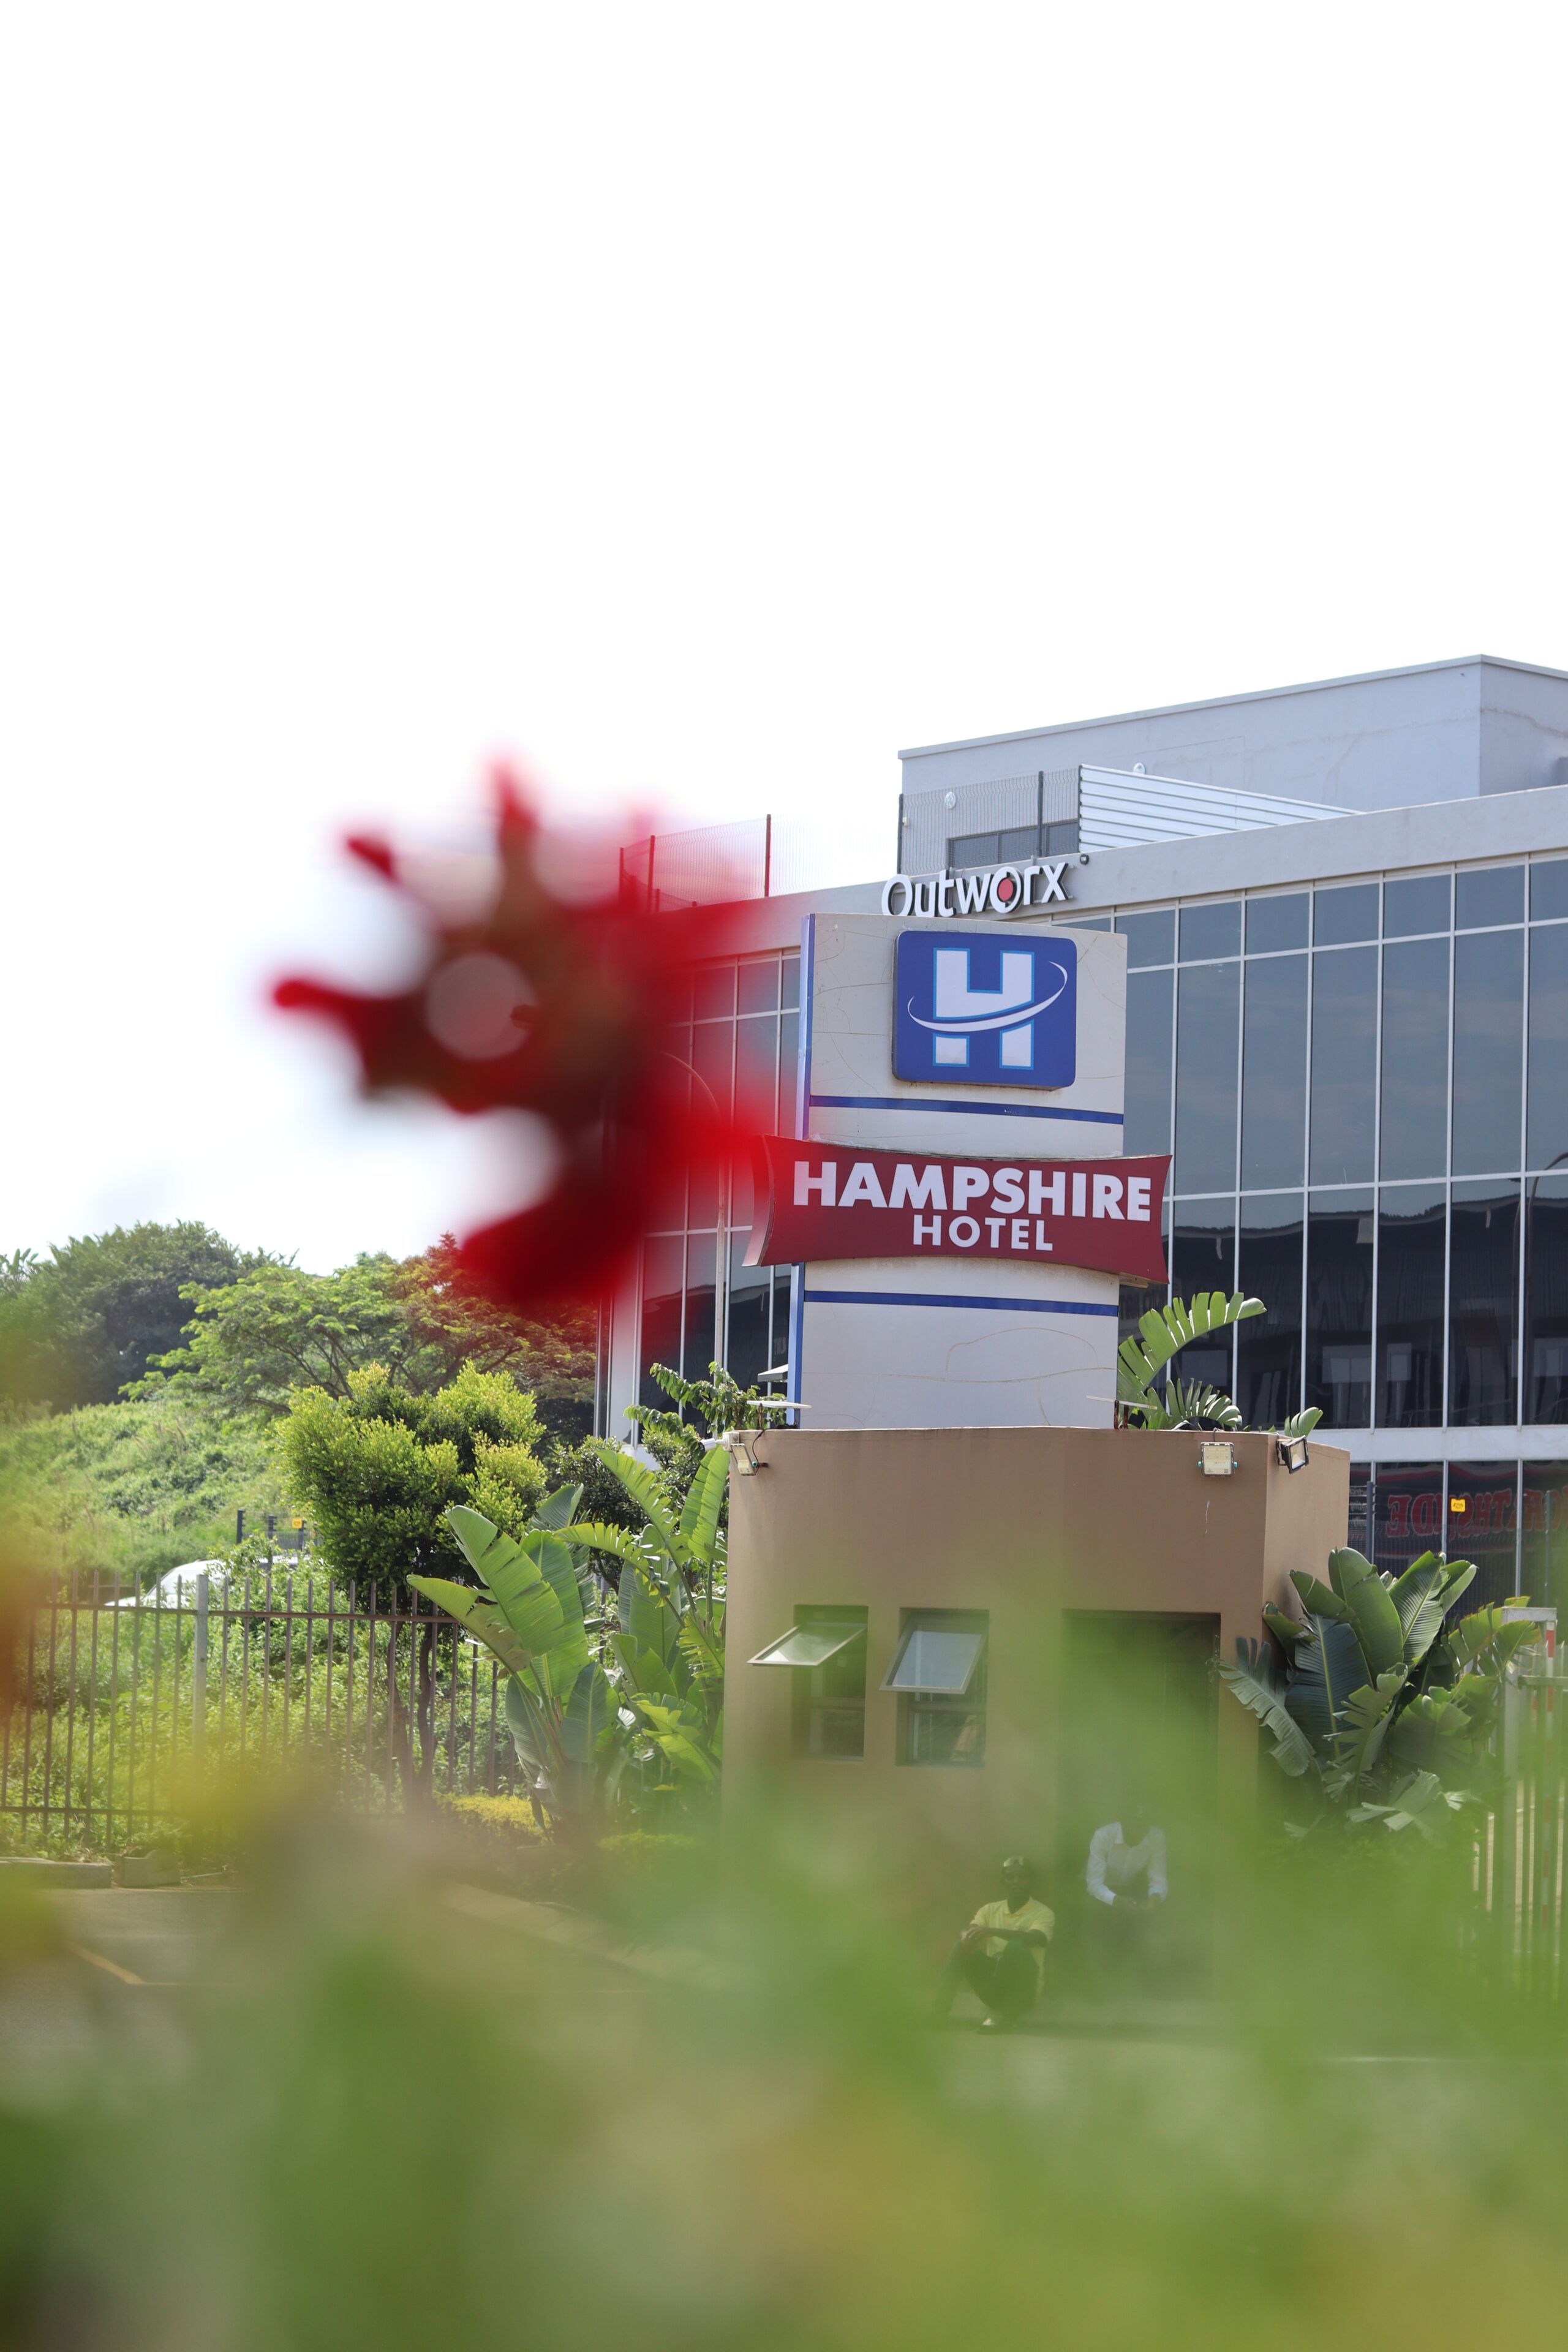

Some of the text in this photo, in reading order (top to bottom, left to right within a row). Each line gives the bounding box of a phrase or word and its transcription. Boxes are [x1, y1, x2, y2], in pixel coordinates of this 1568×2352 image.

[881, 862, 1069, 917] Outworx
[793, 1161, 1152, 1222] HAMPSHIRE
[913, 1215, 1053, 1251] HOTEL
